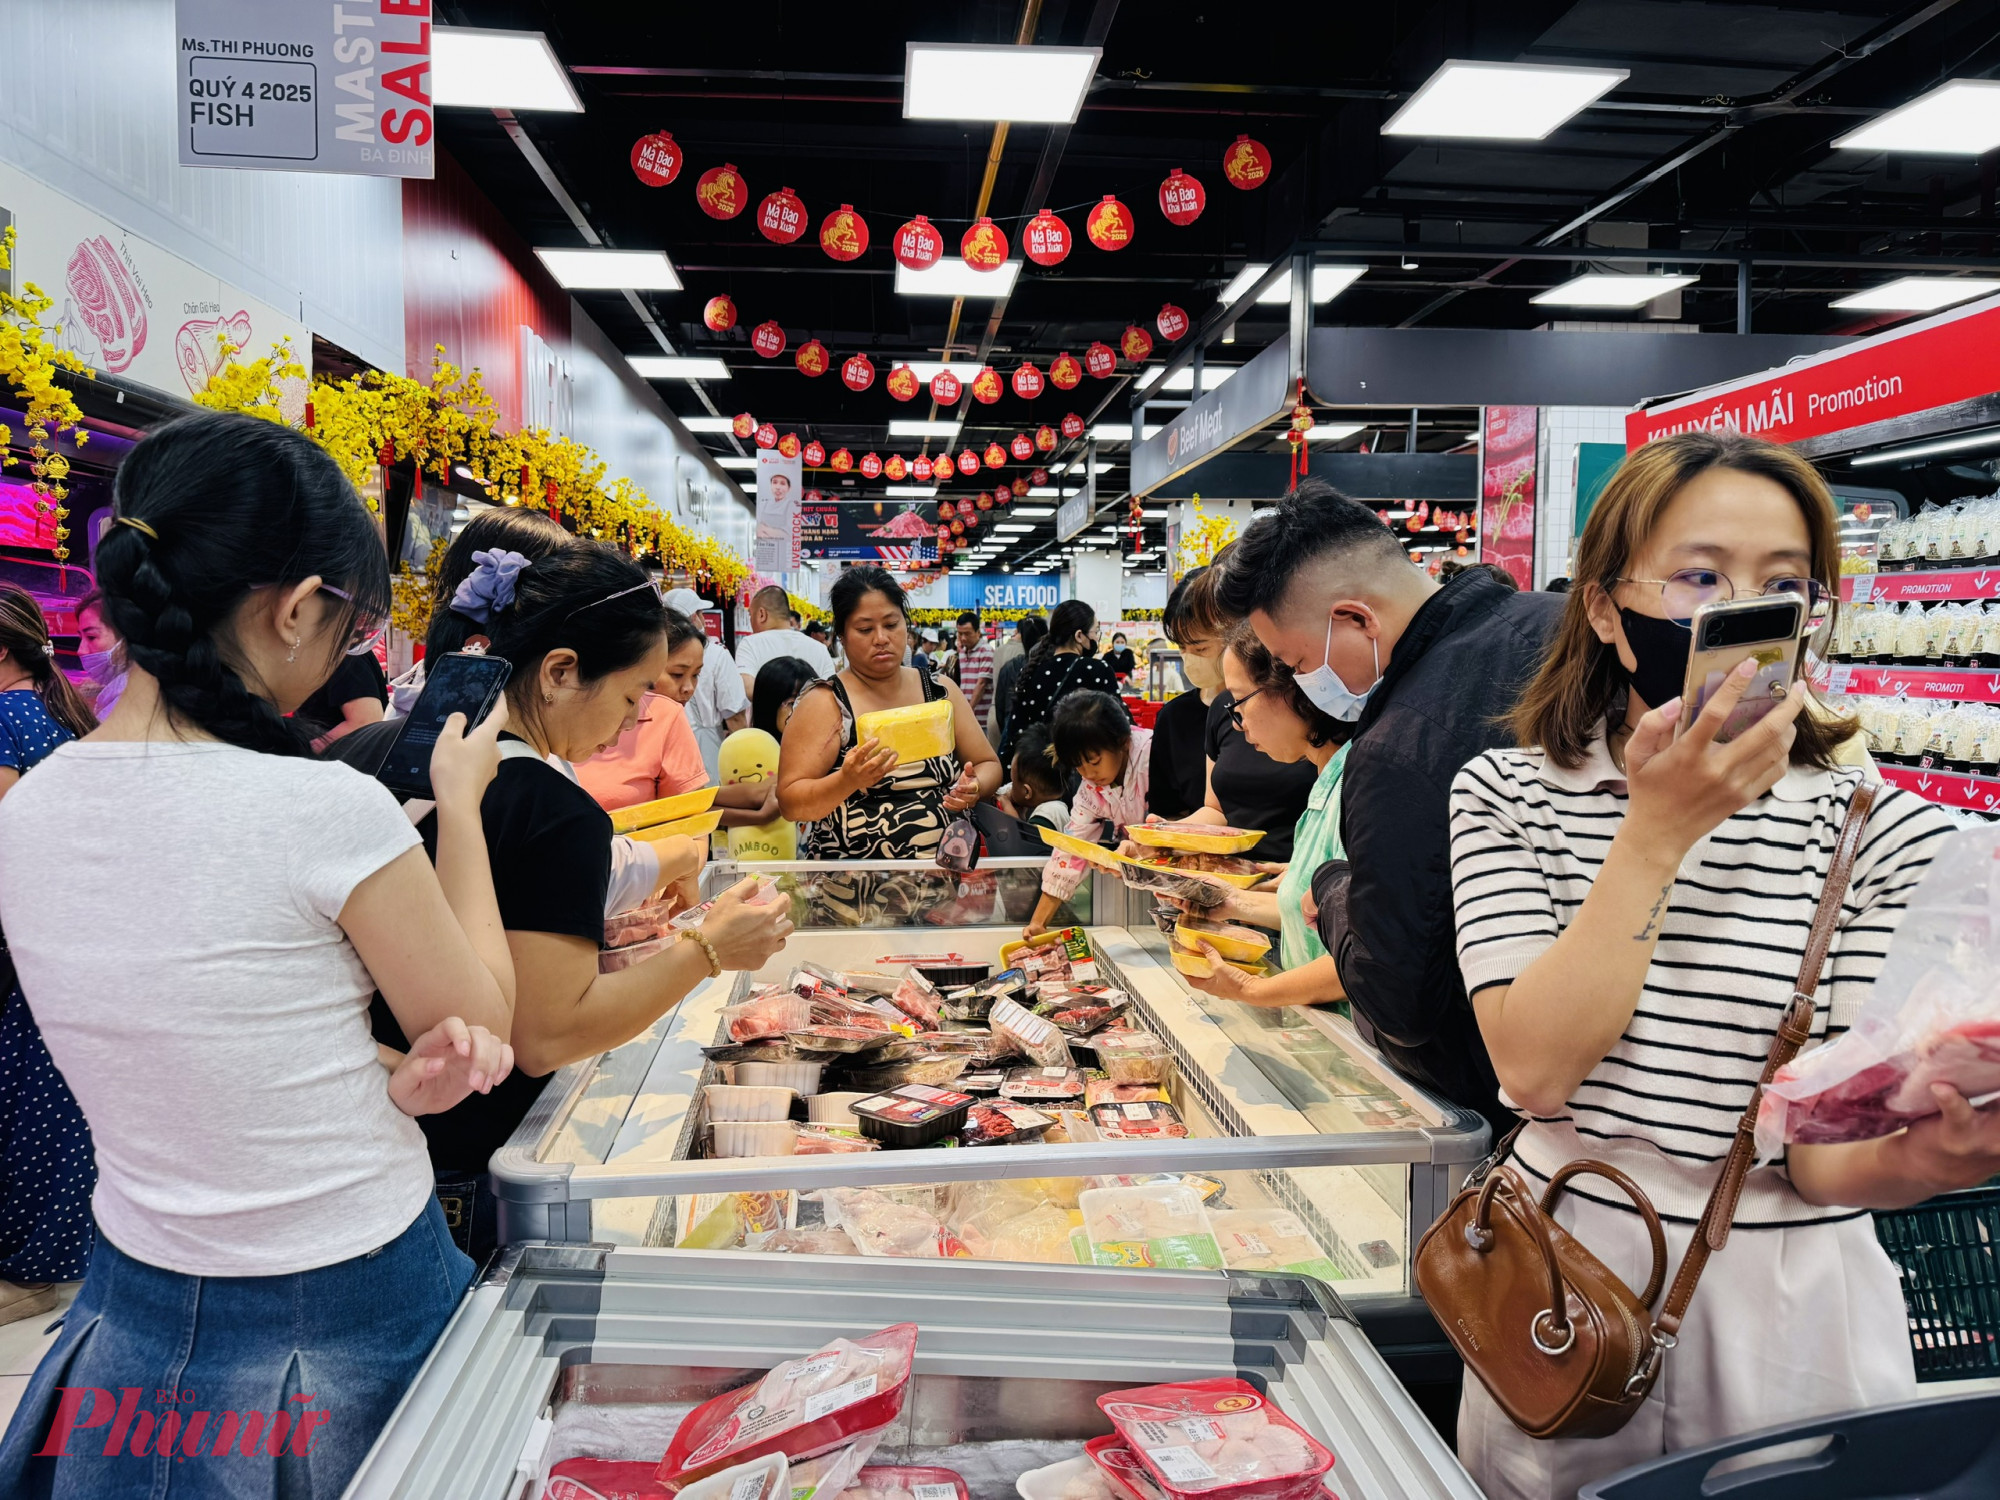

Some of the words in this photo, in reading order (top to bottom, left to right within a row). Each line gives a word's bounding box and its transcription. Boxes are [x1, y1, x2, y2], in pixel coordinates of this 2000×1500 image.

[242, 41, 314, 58] PHUONG
[333, 0, 377, 144] MAST
[189, 75, 237, 99] QUÝ
[241, 82, 255, 99] 4
[259, 83, 312, 103] 2025
[190, 101, 255, 128] FISH
[360, 147, 384, 163] BA
[637, 157, 652, 171] Khai
[1167, 203, 1180, 214] Khai
[763, 216, 778, 230] Khai
[900, 246, 915, 258] Khai
[1032, 243, 1046, 254] Khai
[132, 264, 143, 287] Vai
[140, 284, 153, 309] Heo
[209, 302, 221, 313] Heo
[1747, 387, 1794, 433] MÃI
[1807, 375, 1903, 418] Promotion
[1180, 414, 1199, 456] Beef
[1199, 402, 1223, 443] Meat
[792, 512, 801, 569] LIVESTOCK
[985, 585, 1016, 607] SEA
[1018, 585, 1058, 607] FOOD
[1901, 584, 1951, 594] PROMOTION
